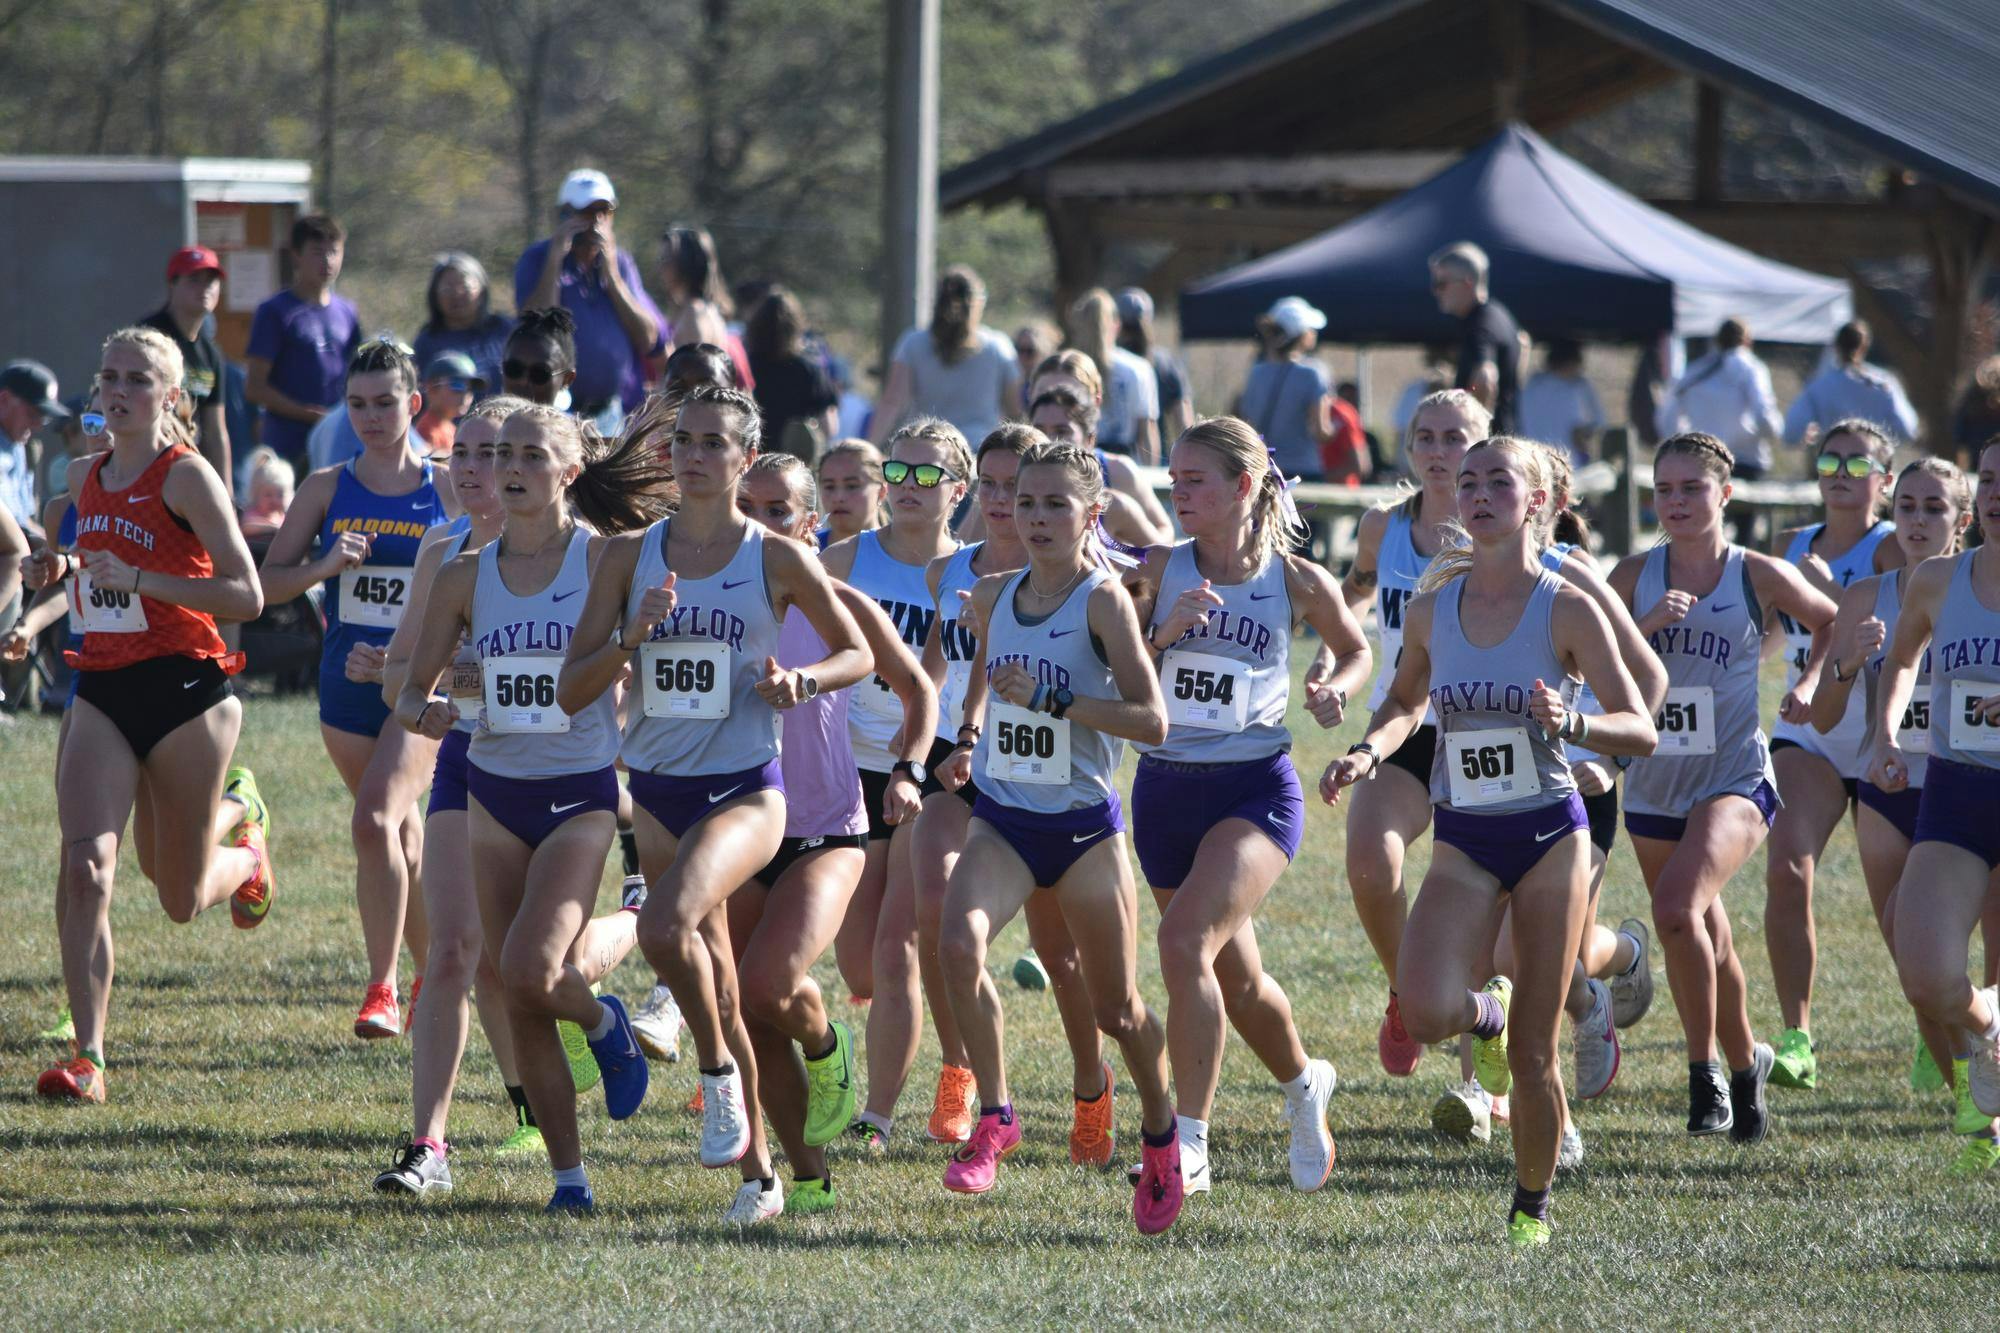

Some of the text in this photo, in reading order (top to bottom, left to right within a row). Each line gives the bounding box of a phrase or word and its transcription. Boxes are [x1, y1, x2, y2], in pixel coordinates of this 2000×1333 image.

[114, 517, 155, 552] TECH
[353, 576, 405, 606] 452
[648, 605, 746, 654] AYLOR
[1170, 609, 1272, 662] AYLOR
[1649, 627, 1732, 671] AYLOR
[496, 673, 555, 708] 566
[655, 658, 715, 693] 569
[1174, 667, 1235, 706] 554
[998, 720, 1055, 759] 560
[1460, 743, 1515, 780] 567
